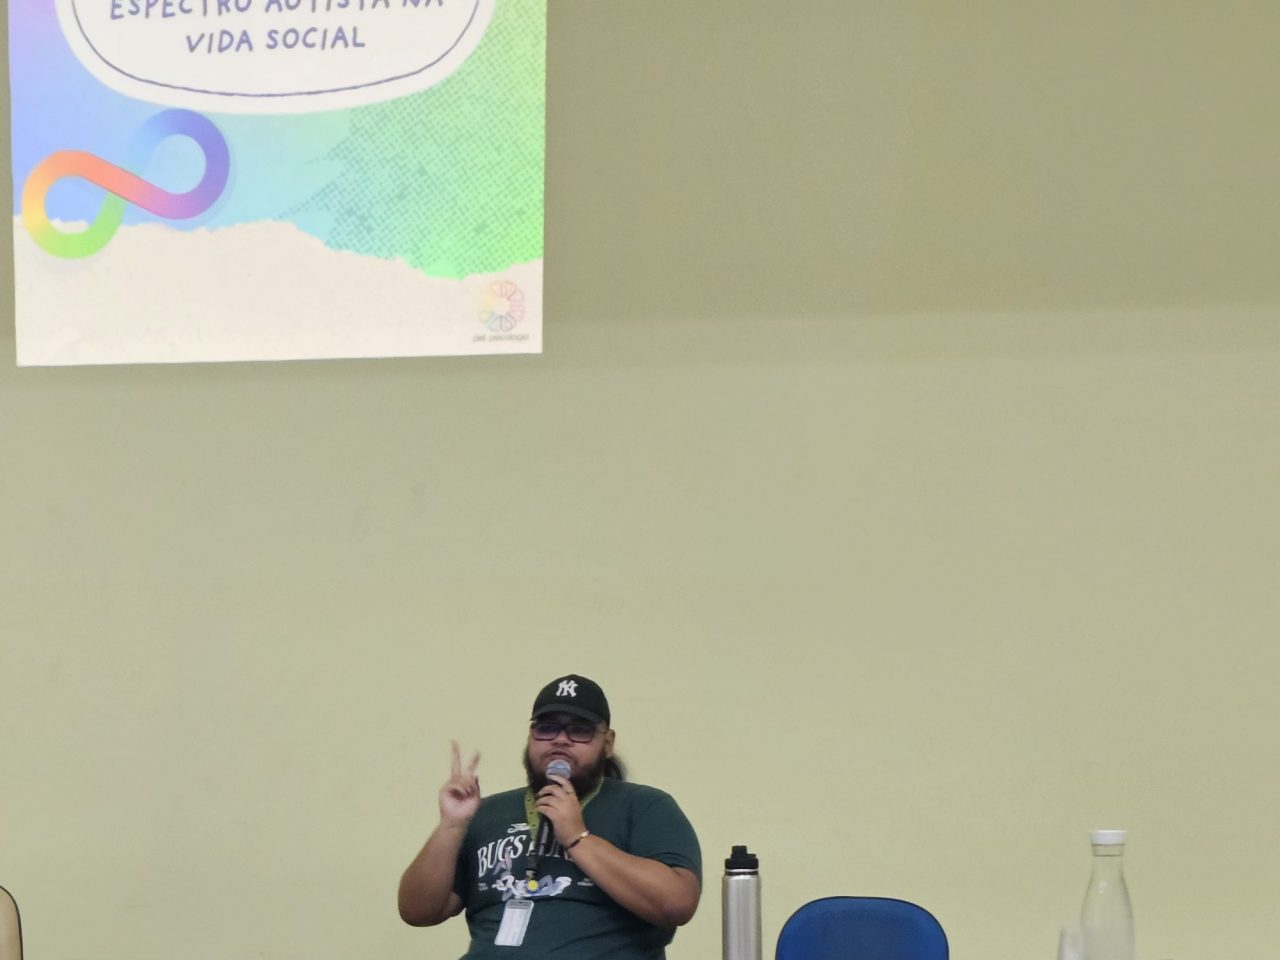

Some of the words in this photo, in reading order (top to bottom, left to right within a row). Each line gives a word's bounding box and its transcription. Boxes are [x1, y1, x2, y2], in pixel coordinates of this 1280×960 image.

[186, 29, 253, 54] VIDA
[266, 26, 365, 51] SOCIAL
[477, 834, 527, 878] BUGS
